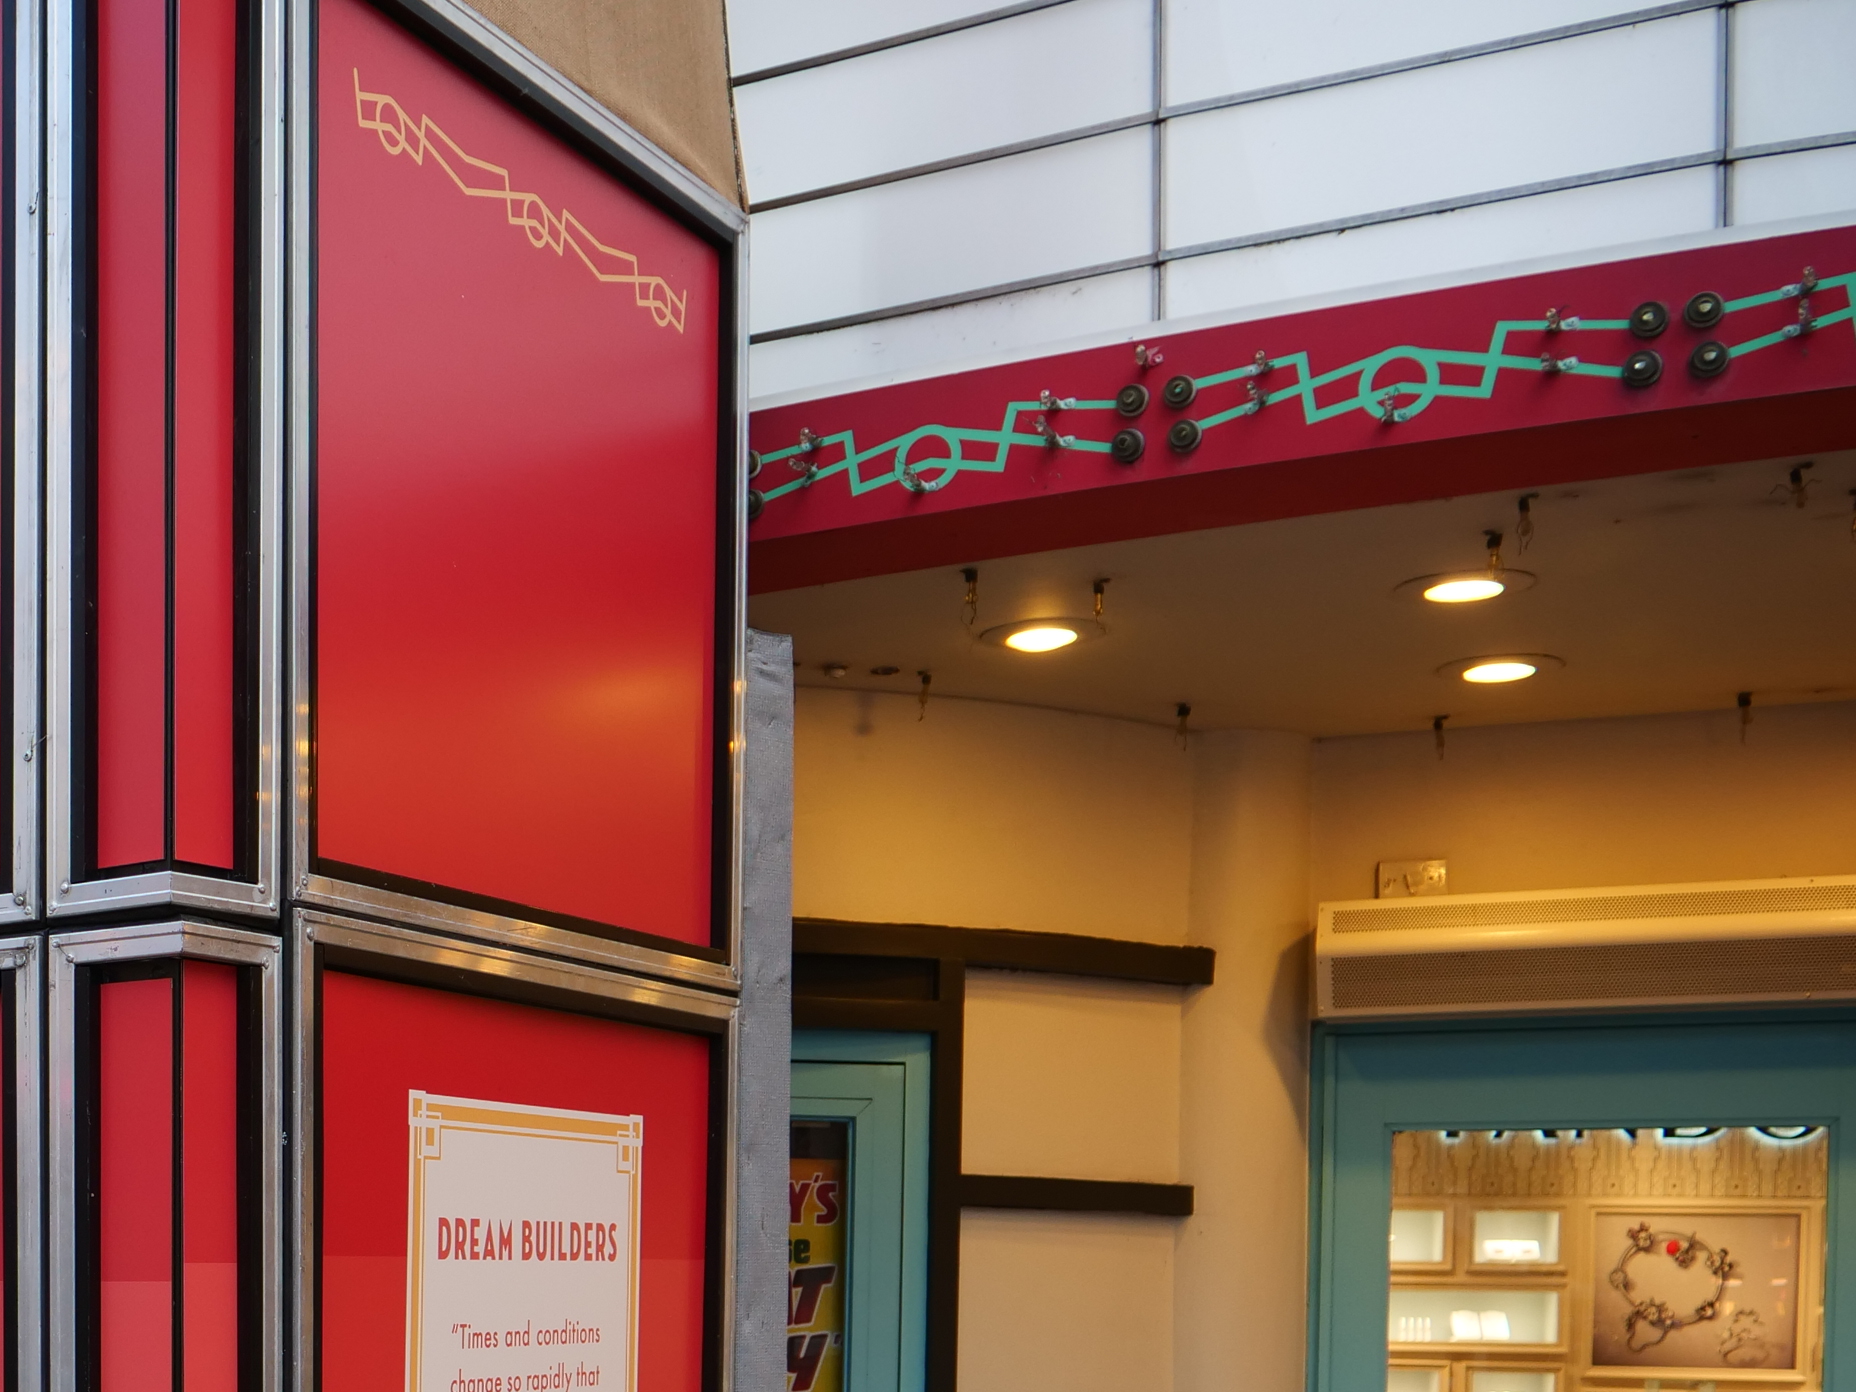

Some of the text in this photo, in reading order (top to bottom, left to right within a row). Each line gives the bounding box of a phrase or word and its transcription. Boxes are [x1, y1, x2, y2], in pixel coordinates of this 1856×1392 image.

[438, 1217, 618, 1262] DREAM BUILDERS
[505, 1319, 531, 1347] and
[536, 1318, 601, 1346] conditions
[507, 1375, 522, 1392] so
[576, 1361, 600, 1387] that
